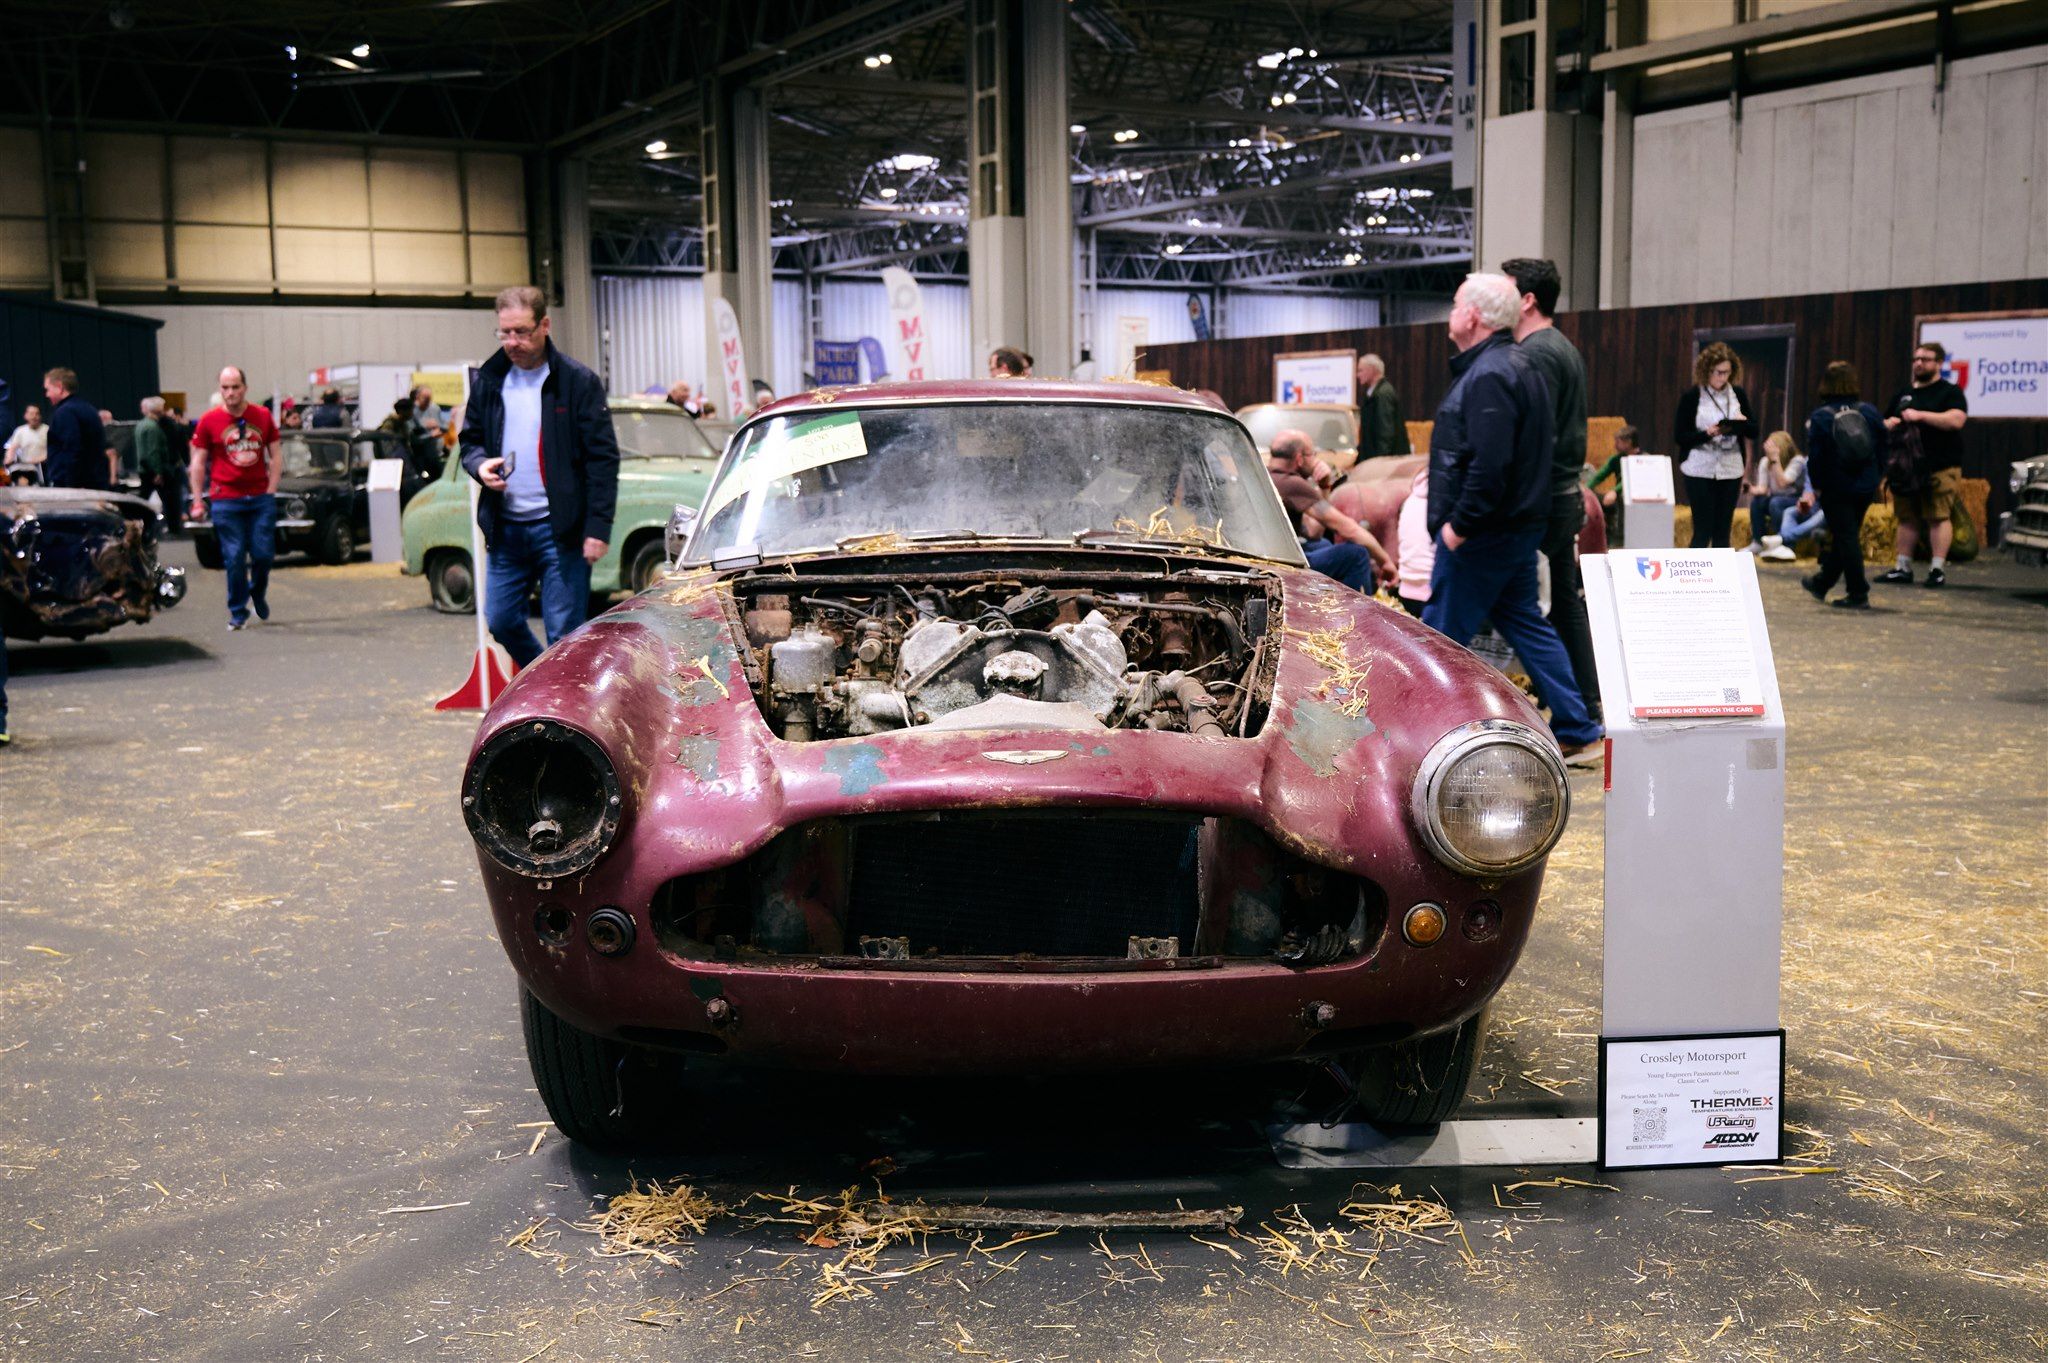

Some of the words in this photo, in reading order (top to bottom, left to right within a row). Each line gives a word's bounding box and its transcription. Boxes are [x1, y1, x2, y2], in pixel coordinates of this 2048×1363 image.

[1964, 330, 2014, 340] Sponsored
[1307, 383, 1347, 396] Footman
[1980, 377, 2037, 397] James
[1665, 559, 1713, 568] Footman
[1669, 568, 1702, 578] James
[1640, 1052, 1684, 1064] Crossley
[1687, 1051, 1746, 1063] Motorsport
[1690, 1097, 1773, 1108] THERMEX
[1705, 1132, 1760, 1144] ALDON
